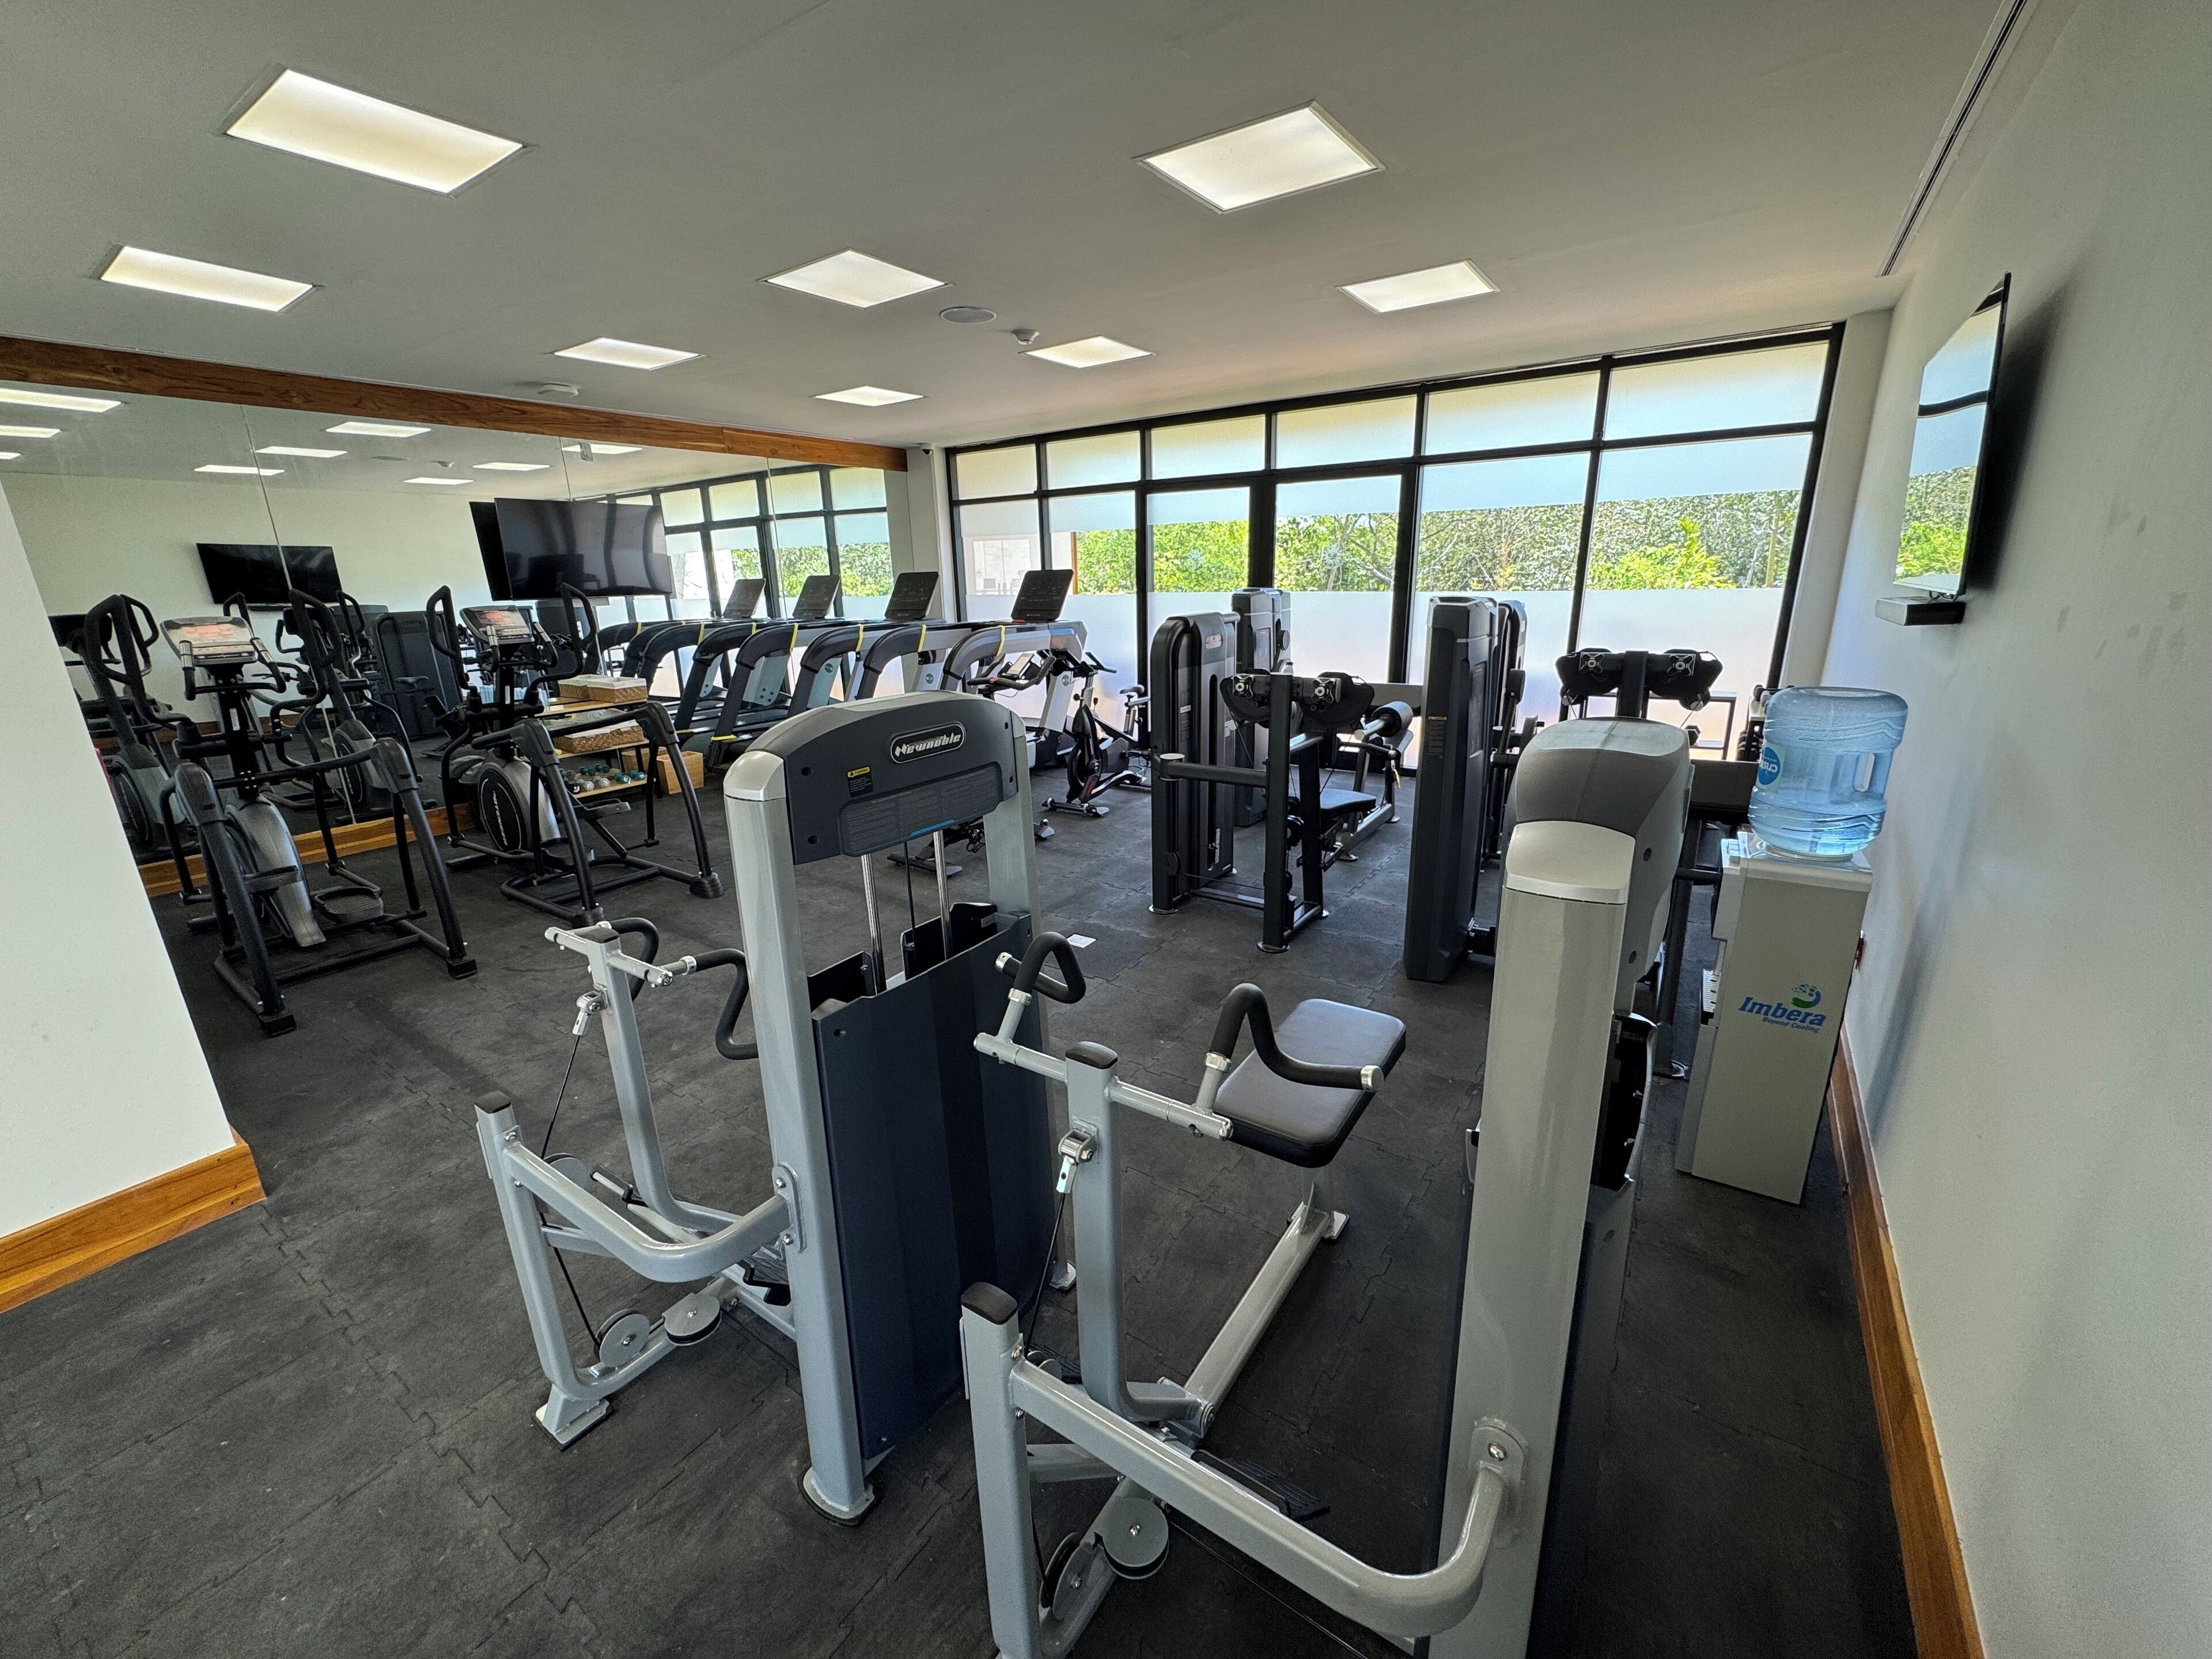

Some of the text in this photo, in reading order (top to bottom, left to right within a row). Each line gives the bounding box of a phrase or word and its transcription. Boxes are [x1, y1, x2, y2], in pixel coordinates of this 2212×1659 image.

[895, 732, 961, 757] Newnoble
[1738, 997, 1826, 1026] Imbera
[1762, 1016, 1820, 1033] Beyond Cooling
